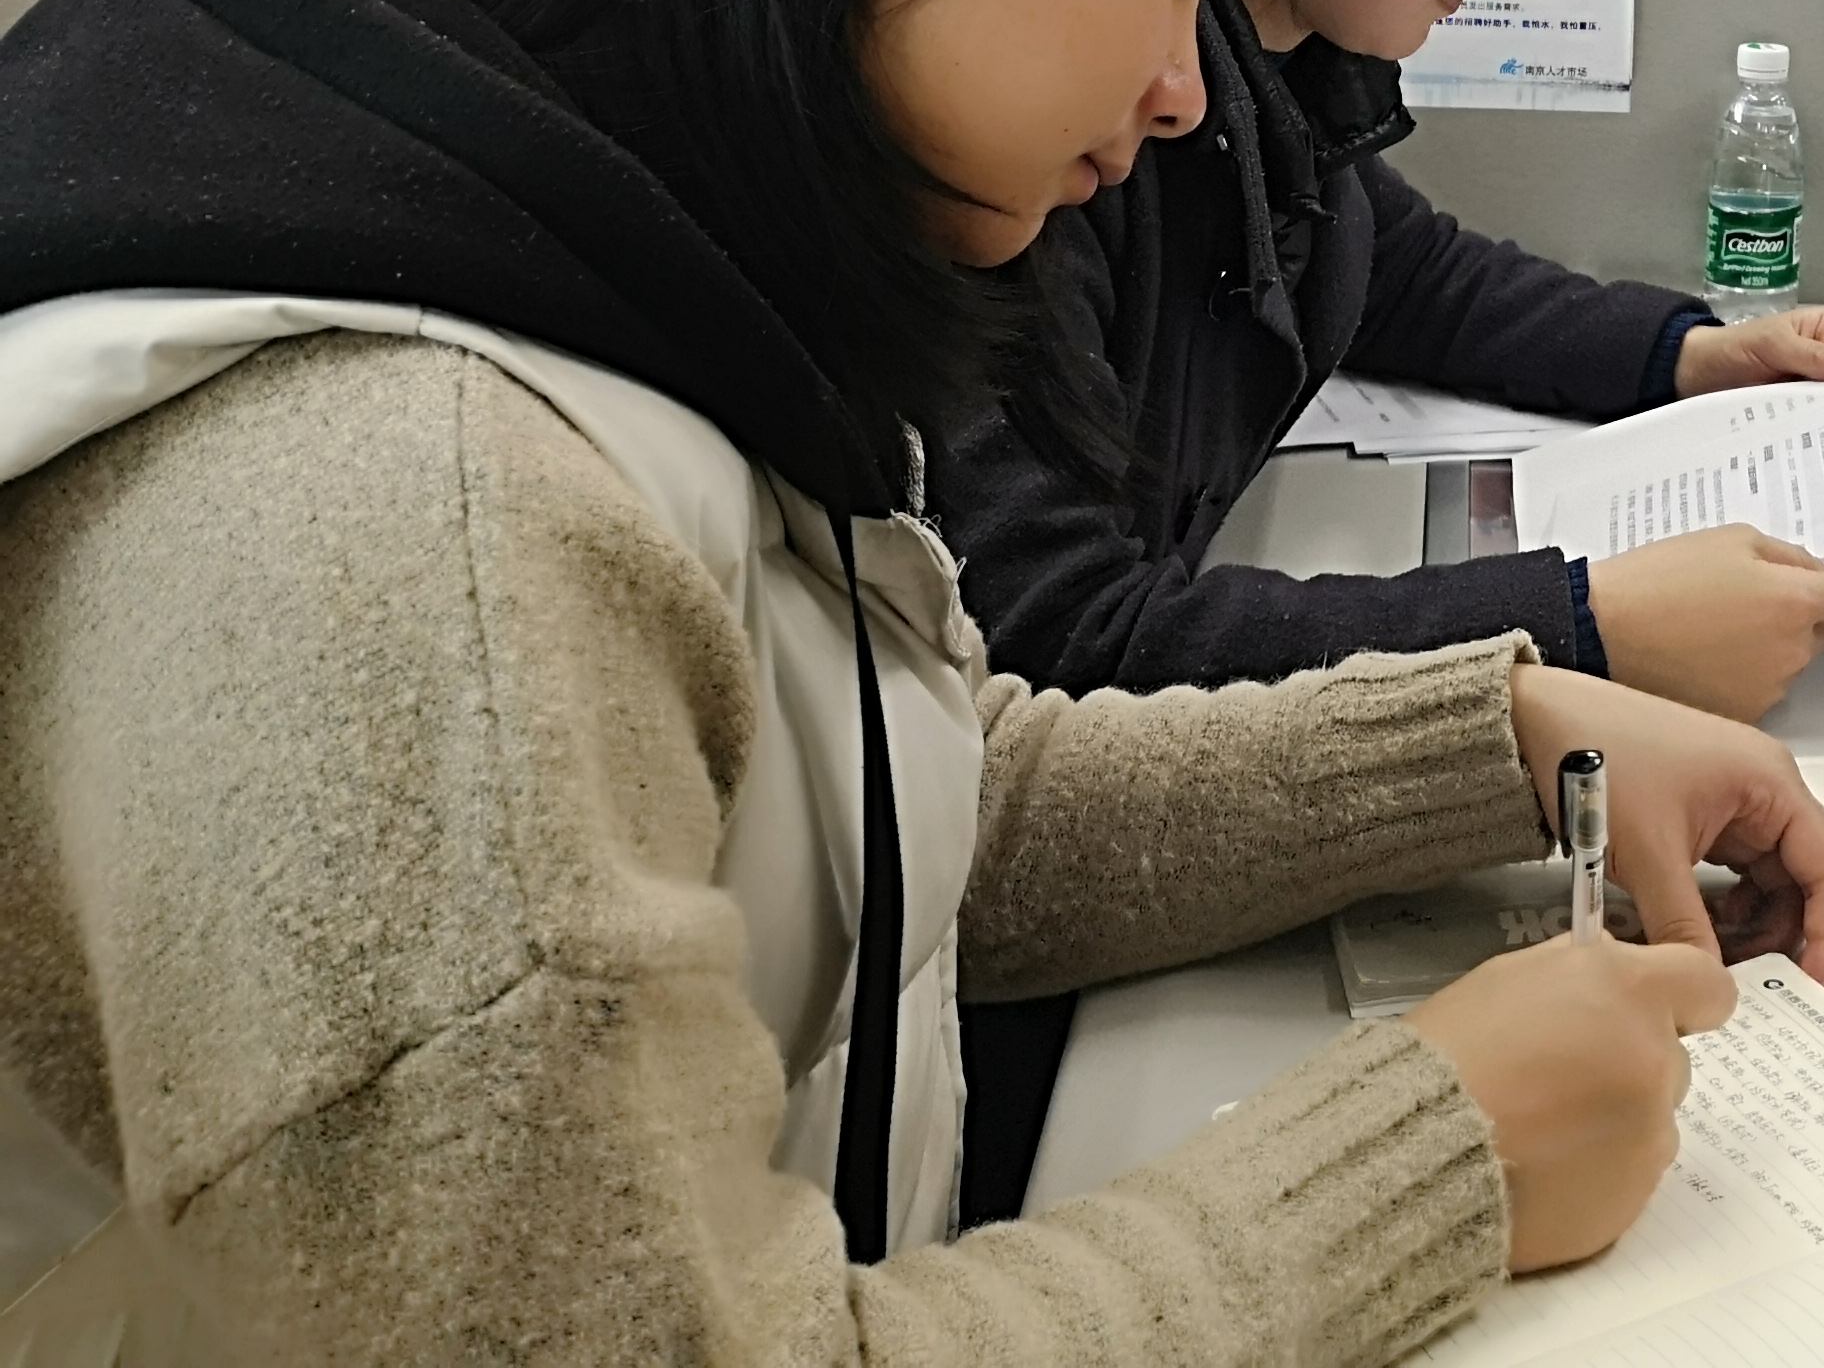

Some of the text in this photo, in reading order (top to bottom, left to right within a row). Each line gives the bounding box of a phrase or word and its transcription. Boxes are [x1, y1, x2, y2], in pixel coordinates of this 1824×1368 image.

[1525, 65, 1588, 77] 南京人才市场
